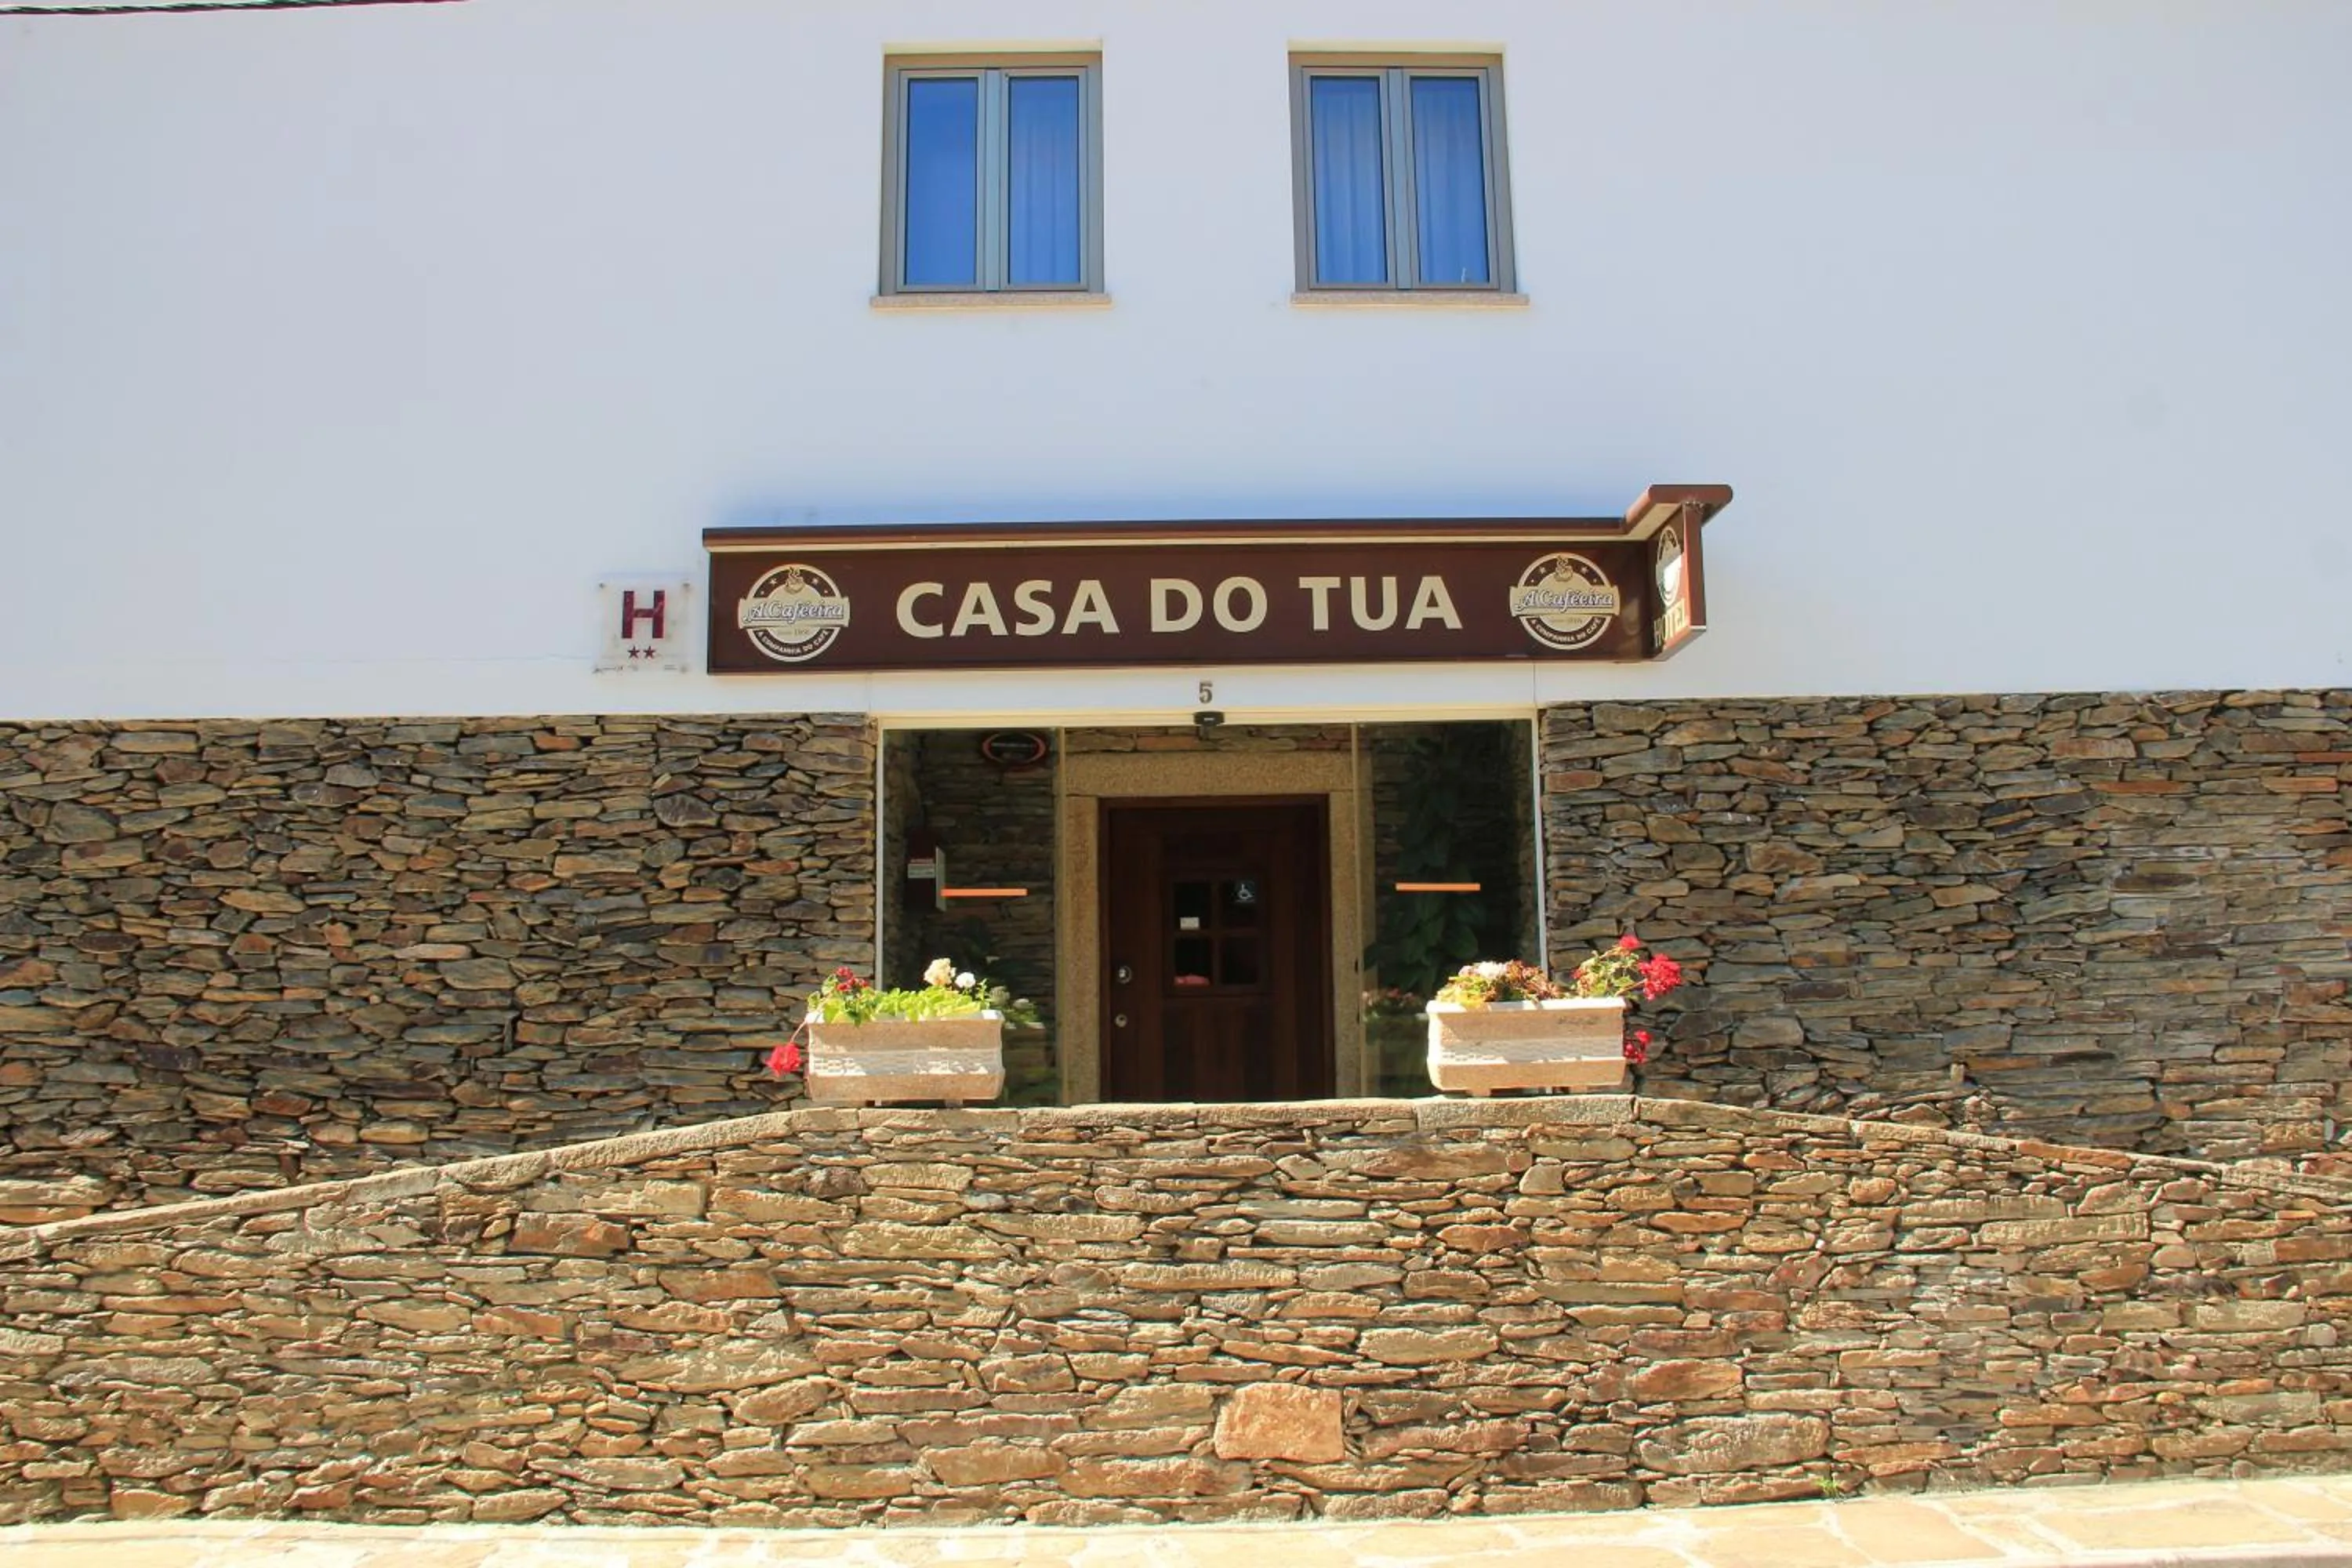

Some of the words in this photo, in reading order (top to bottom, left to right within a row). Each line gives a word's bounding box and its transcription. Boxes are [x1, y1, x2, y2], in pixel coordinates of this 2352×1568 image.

[622, 590, 666, 639] H
[896, 579, 1120, 638] CASA
[1150, 576, 1268, 633] DO
[1298, 575, 1463, 631] TUA
[1653, 597, 1686, 648] HOTEL
[1199, 681, 1213, 704] 5
